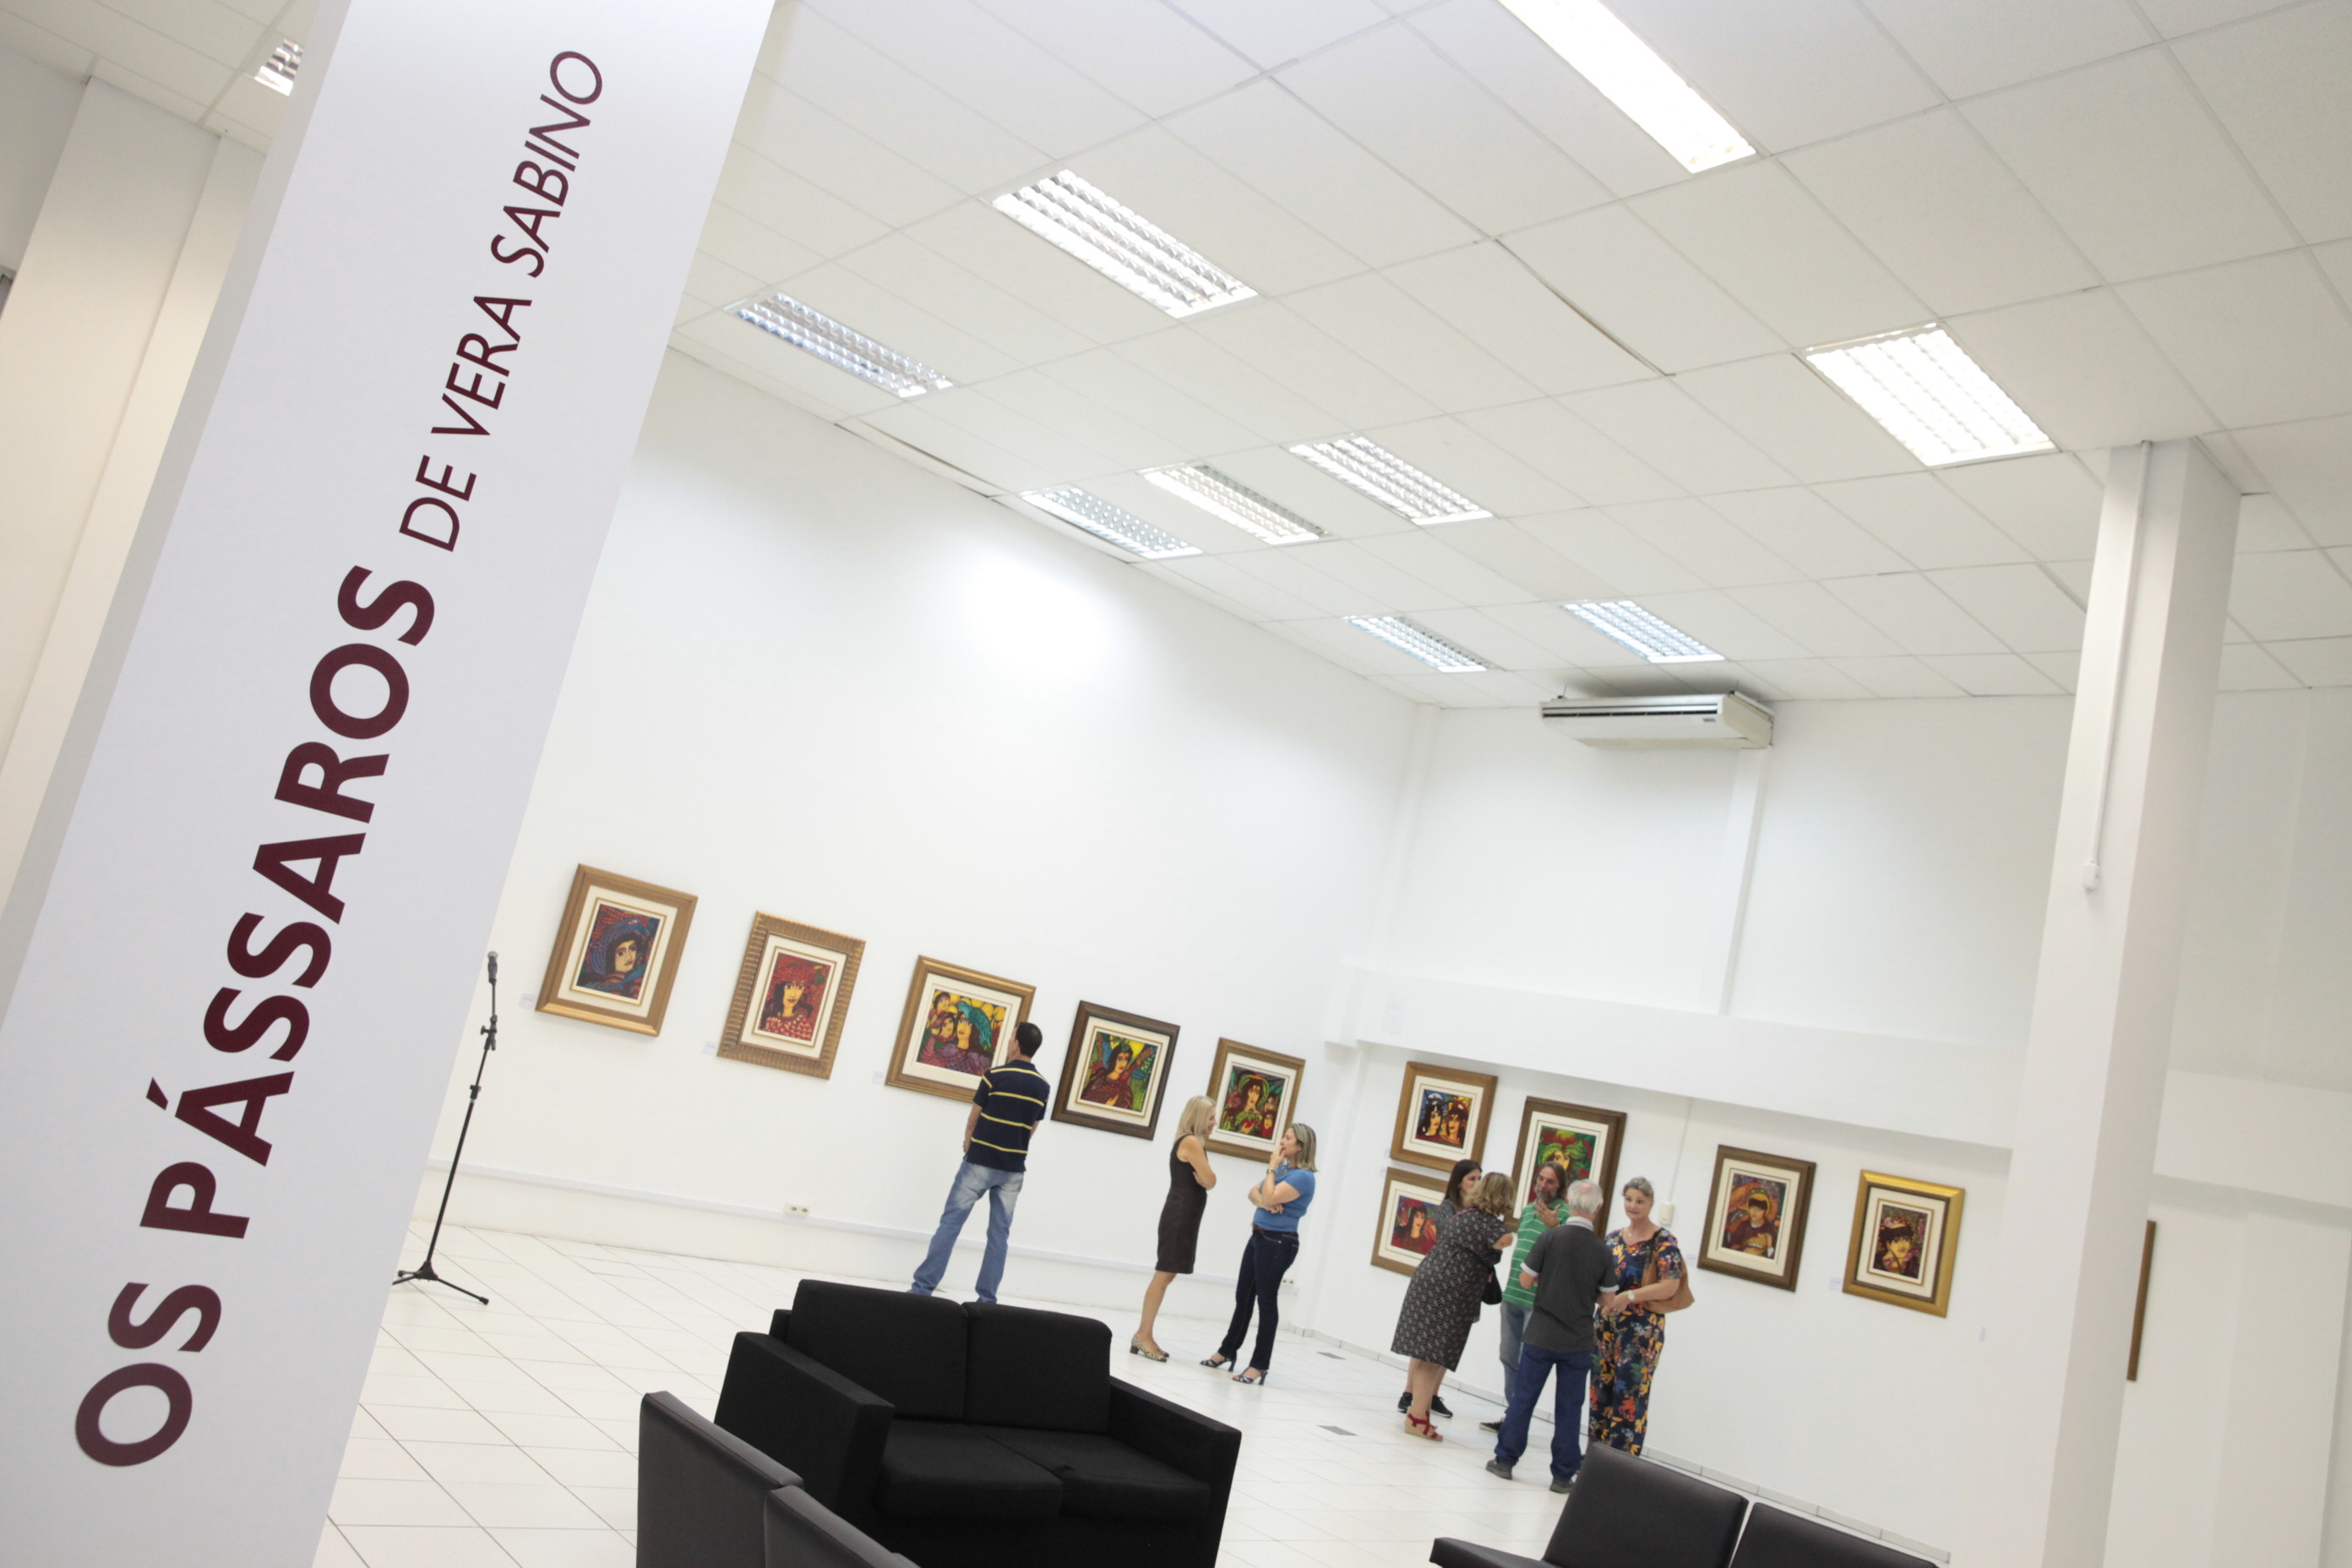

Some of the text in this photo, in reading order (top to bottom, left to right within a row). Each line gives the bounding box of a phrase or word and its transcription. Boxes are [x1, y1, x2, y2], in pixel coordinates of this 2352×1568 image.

[77, 51, 603, 1467] OS PÁSSAROS DE VERA SABINO
